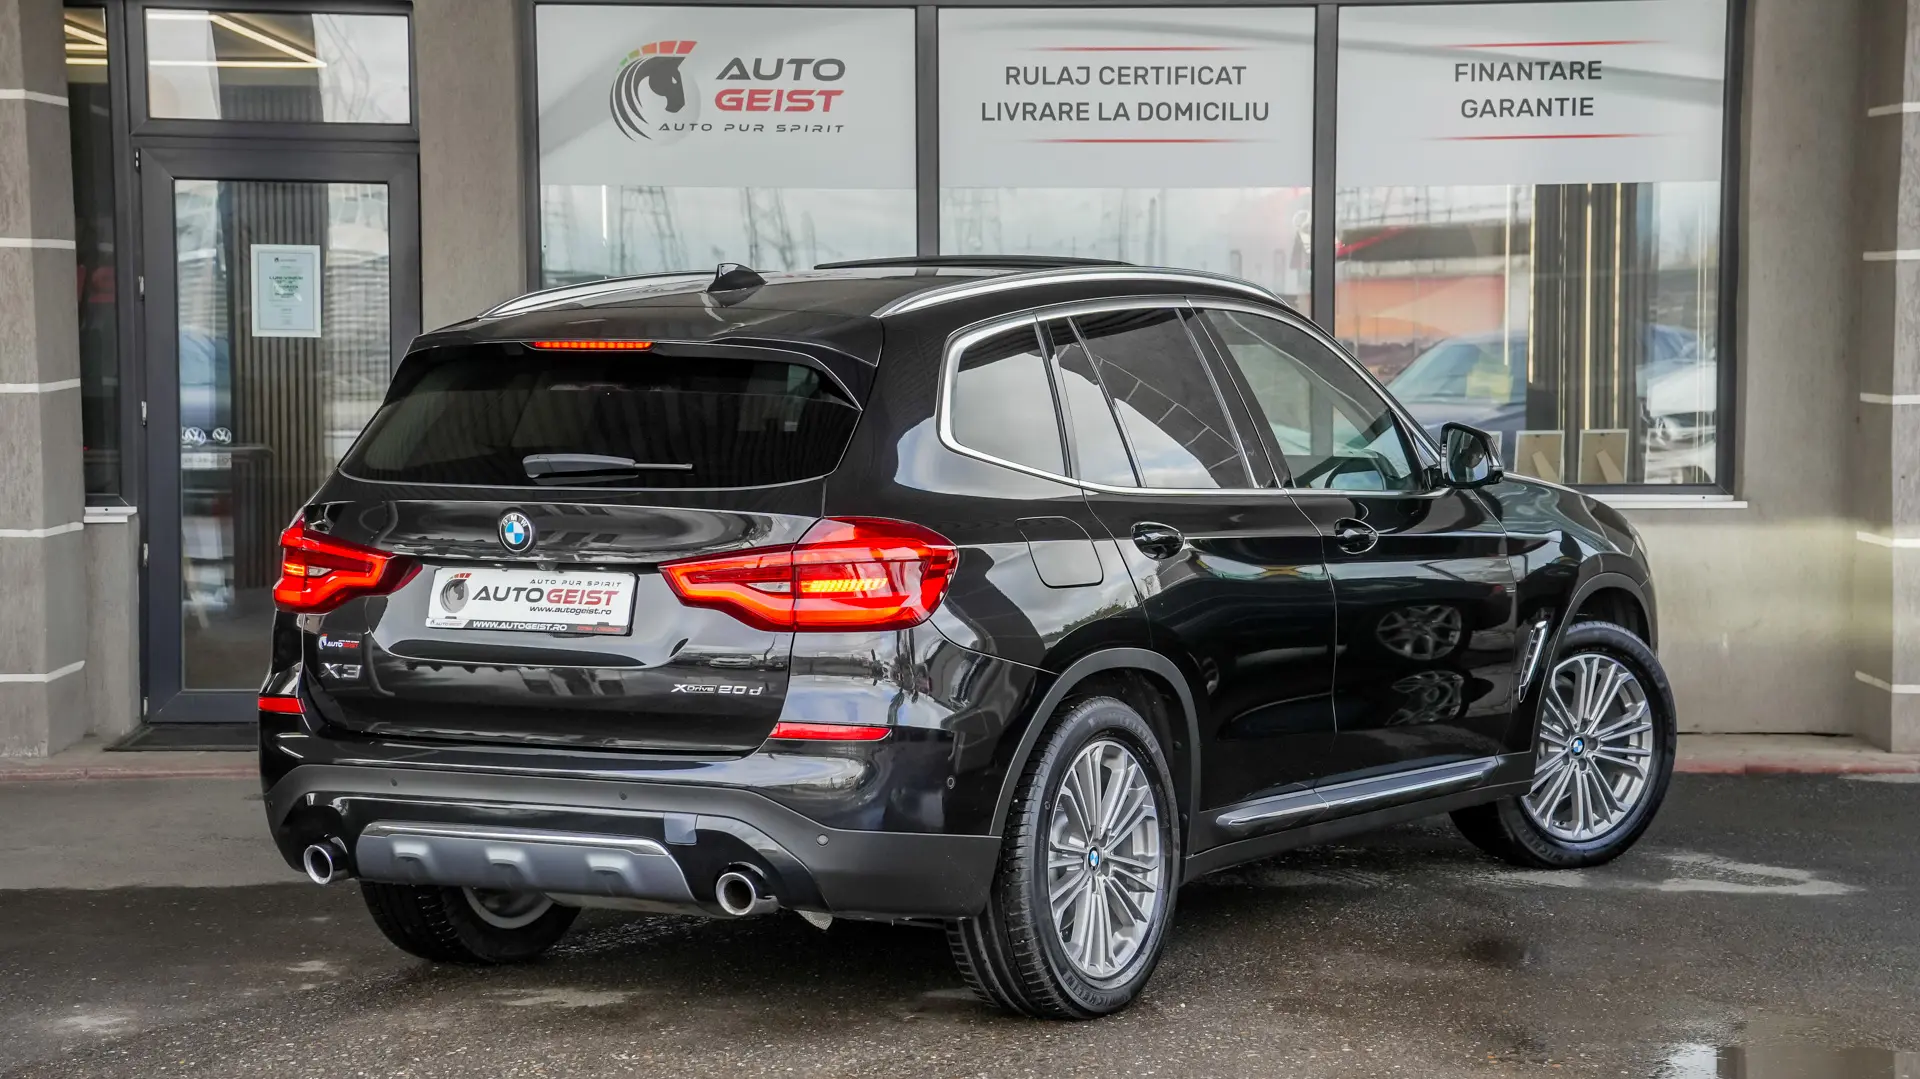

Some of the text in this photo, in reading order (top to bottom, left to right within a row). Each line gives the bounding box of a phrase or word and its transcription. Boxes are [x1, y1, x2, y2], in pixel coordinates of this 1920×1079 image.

[715, 57, 846, 81] AUTO
[1005, 65, 1247, 86] RULAJ CERTIFICAT
[1454, 60, 1602, 83] FINANTARE
[714, 88, 845, 112] GEIST
[1461, 96, 1594, 119] GARANTIE
[981, 101, 1269, 122] LIVRARE LA DOMICILIU
[658, 122, 845, 134] AUTO PUR SPIRIT
[529, 606, 612, 616] www.autogeist.ro
[472, 620, 568, 631] WWW.AUTOGEIST.RO
[320, 662, 363, 679] X3
